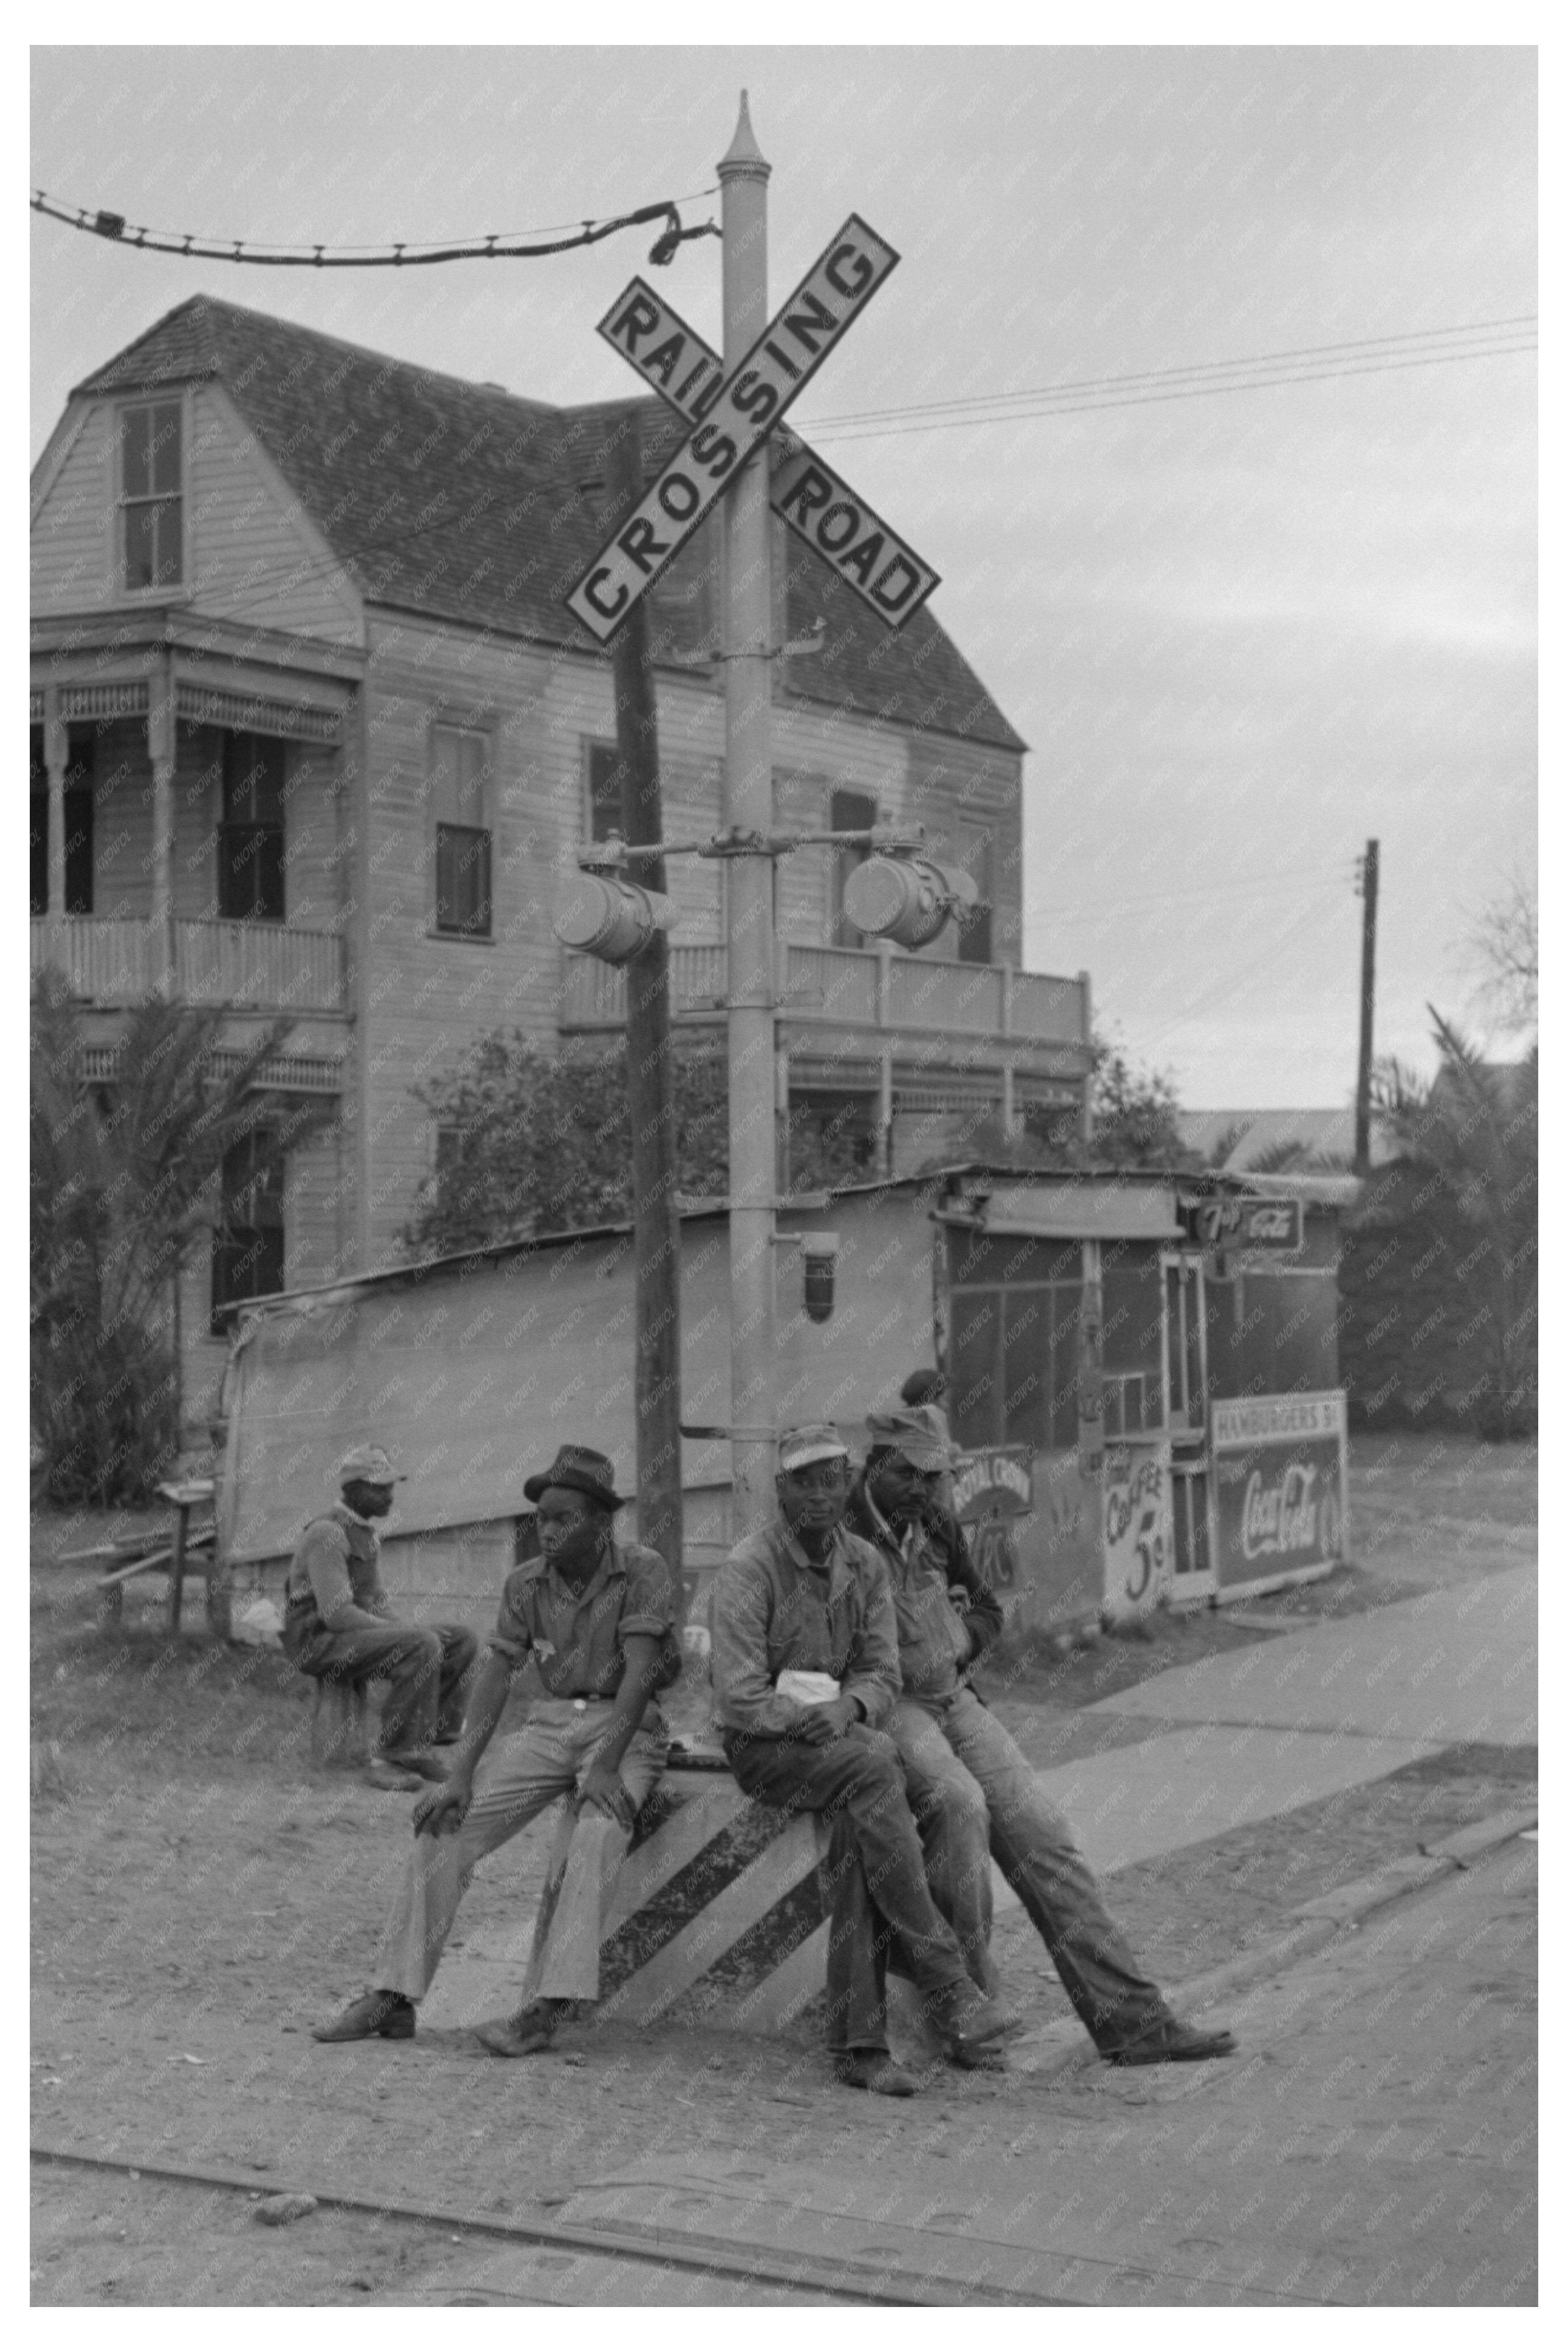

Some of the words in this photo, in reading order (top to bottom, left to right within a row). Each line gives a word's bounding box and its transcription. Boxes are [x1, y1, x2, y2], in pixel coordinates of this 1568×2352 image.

[583, 244, 875, 620] CROSSING
[610, 292, 724, 423] RAIL
[781, 465, 921, 613] ROAD
[1219, 1405, 1317, 1440] HAMBURGERS
